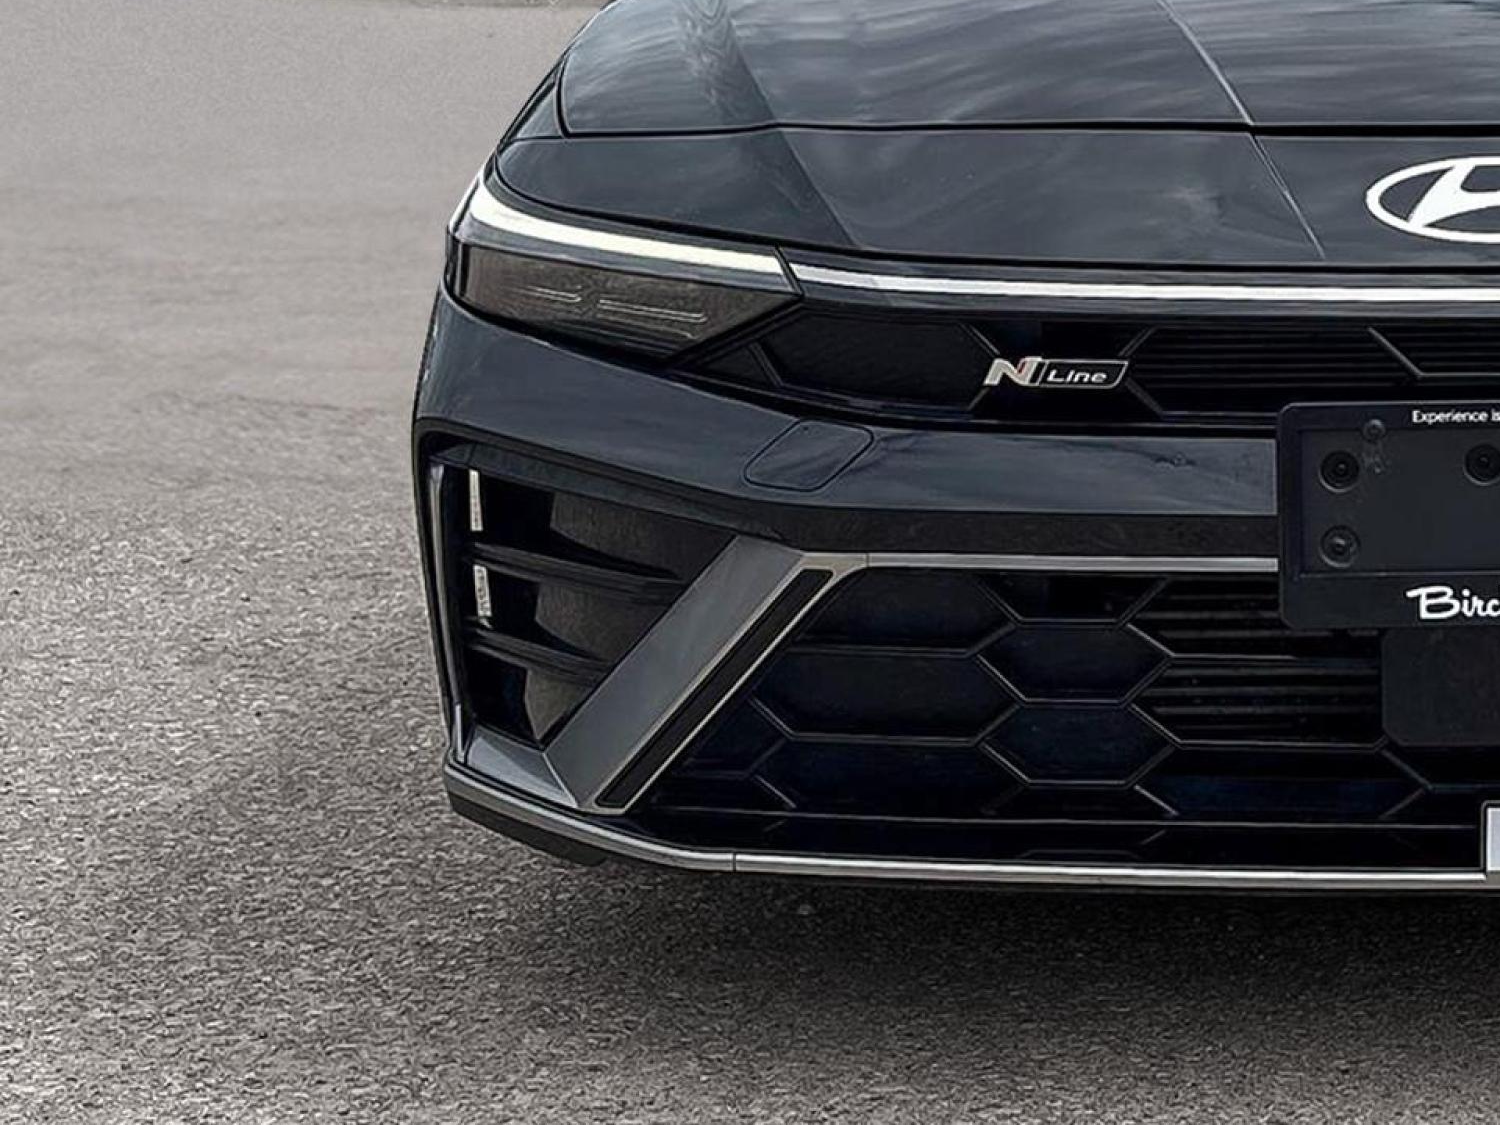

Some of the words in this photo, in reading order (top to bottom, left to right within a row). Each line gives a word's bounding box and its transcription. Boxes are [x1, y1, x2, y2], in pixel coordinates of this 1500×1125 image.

[1046, 369, 1107, 383] Line
[1411, 410, 1489, 425] Experience
[1491, 409, 1500, 421] is
